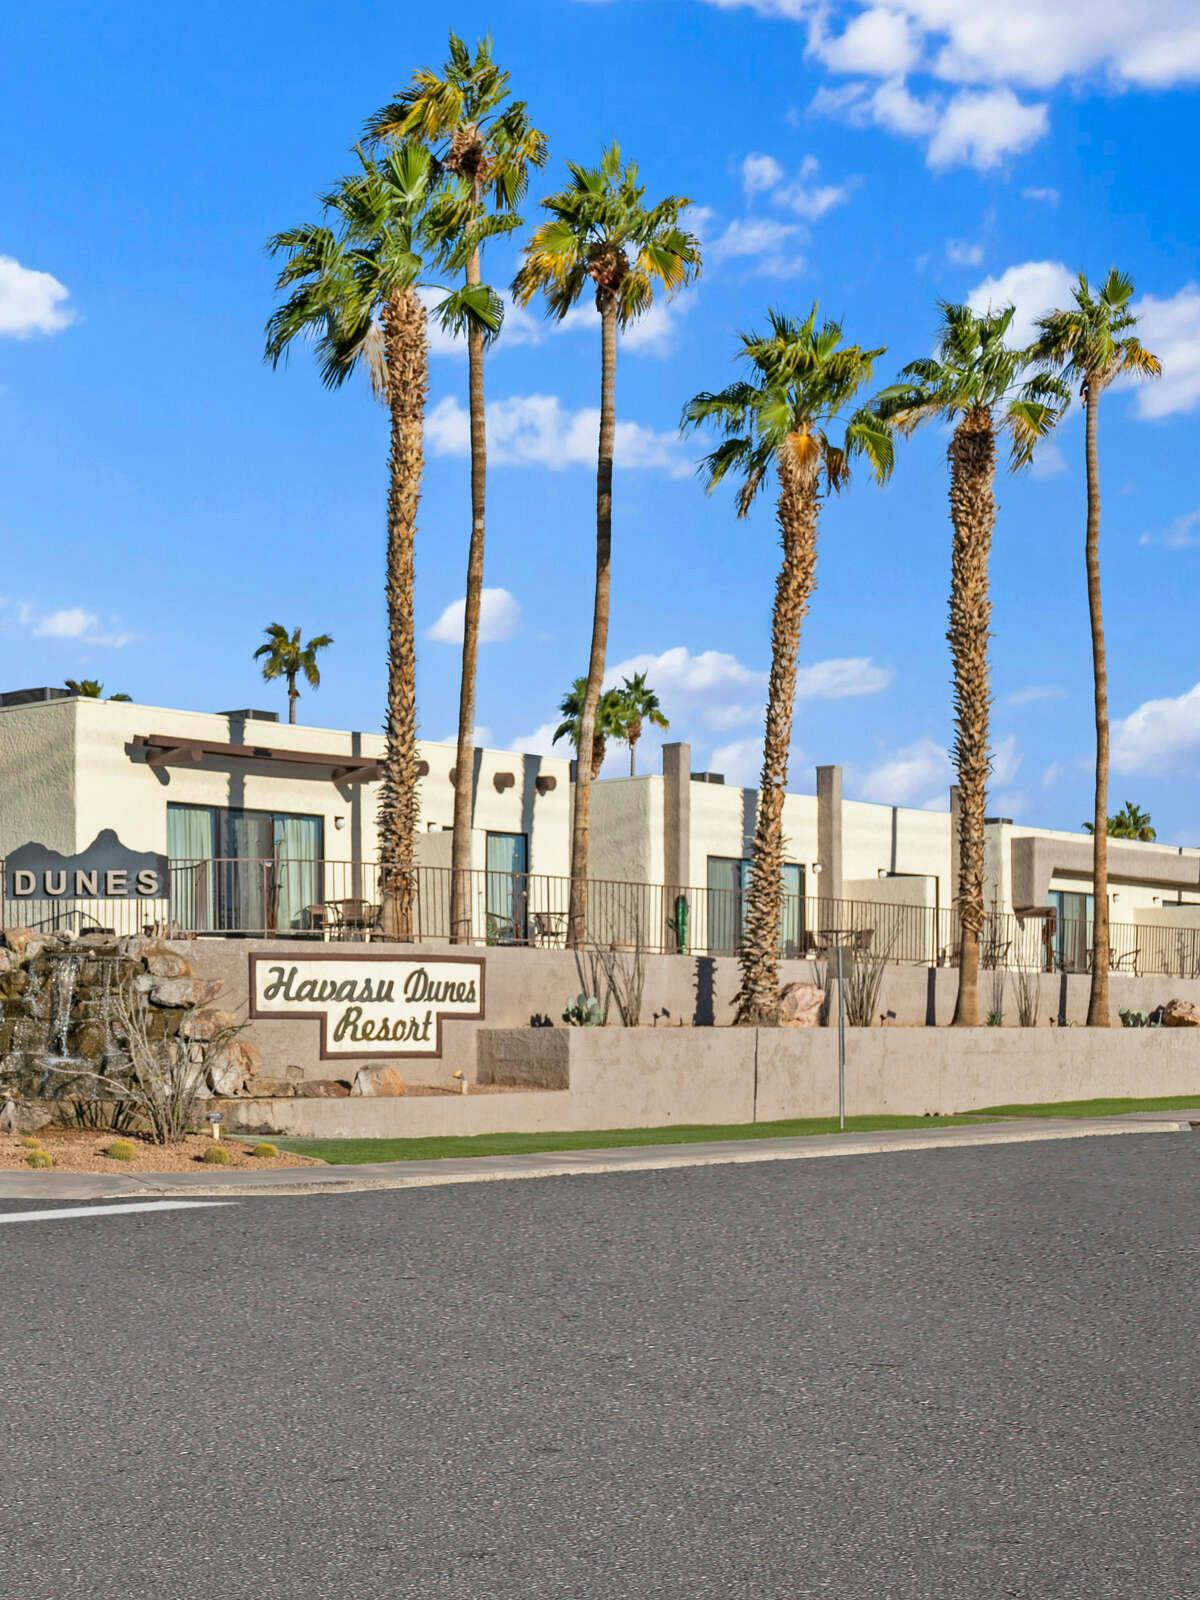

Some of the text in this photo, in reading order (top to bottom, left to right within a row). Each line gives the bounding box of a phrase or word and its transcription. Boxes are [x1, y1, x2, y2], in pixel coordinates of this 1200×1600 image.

[13, 869, 159, 896] DUNES
[263, 966, 476, 1003] Havasu Dunes
[332, 1006, 433, 1042] Resort
